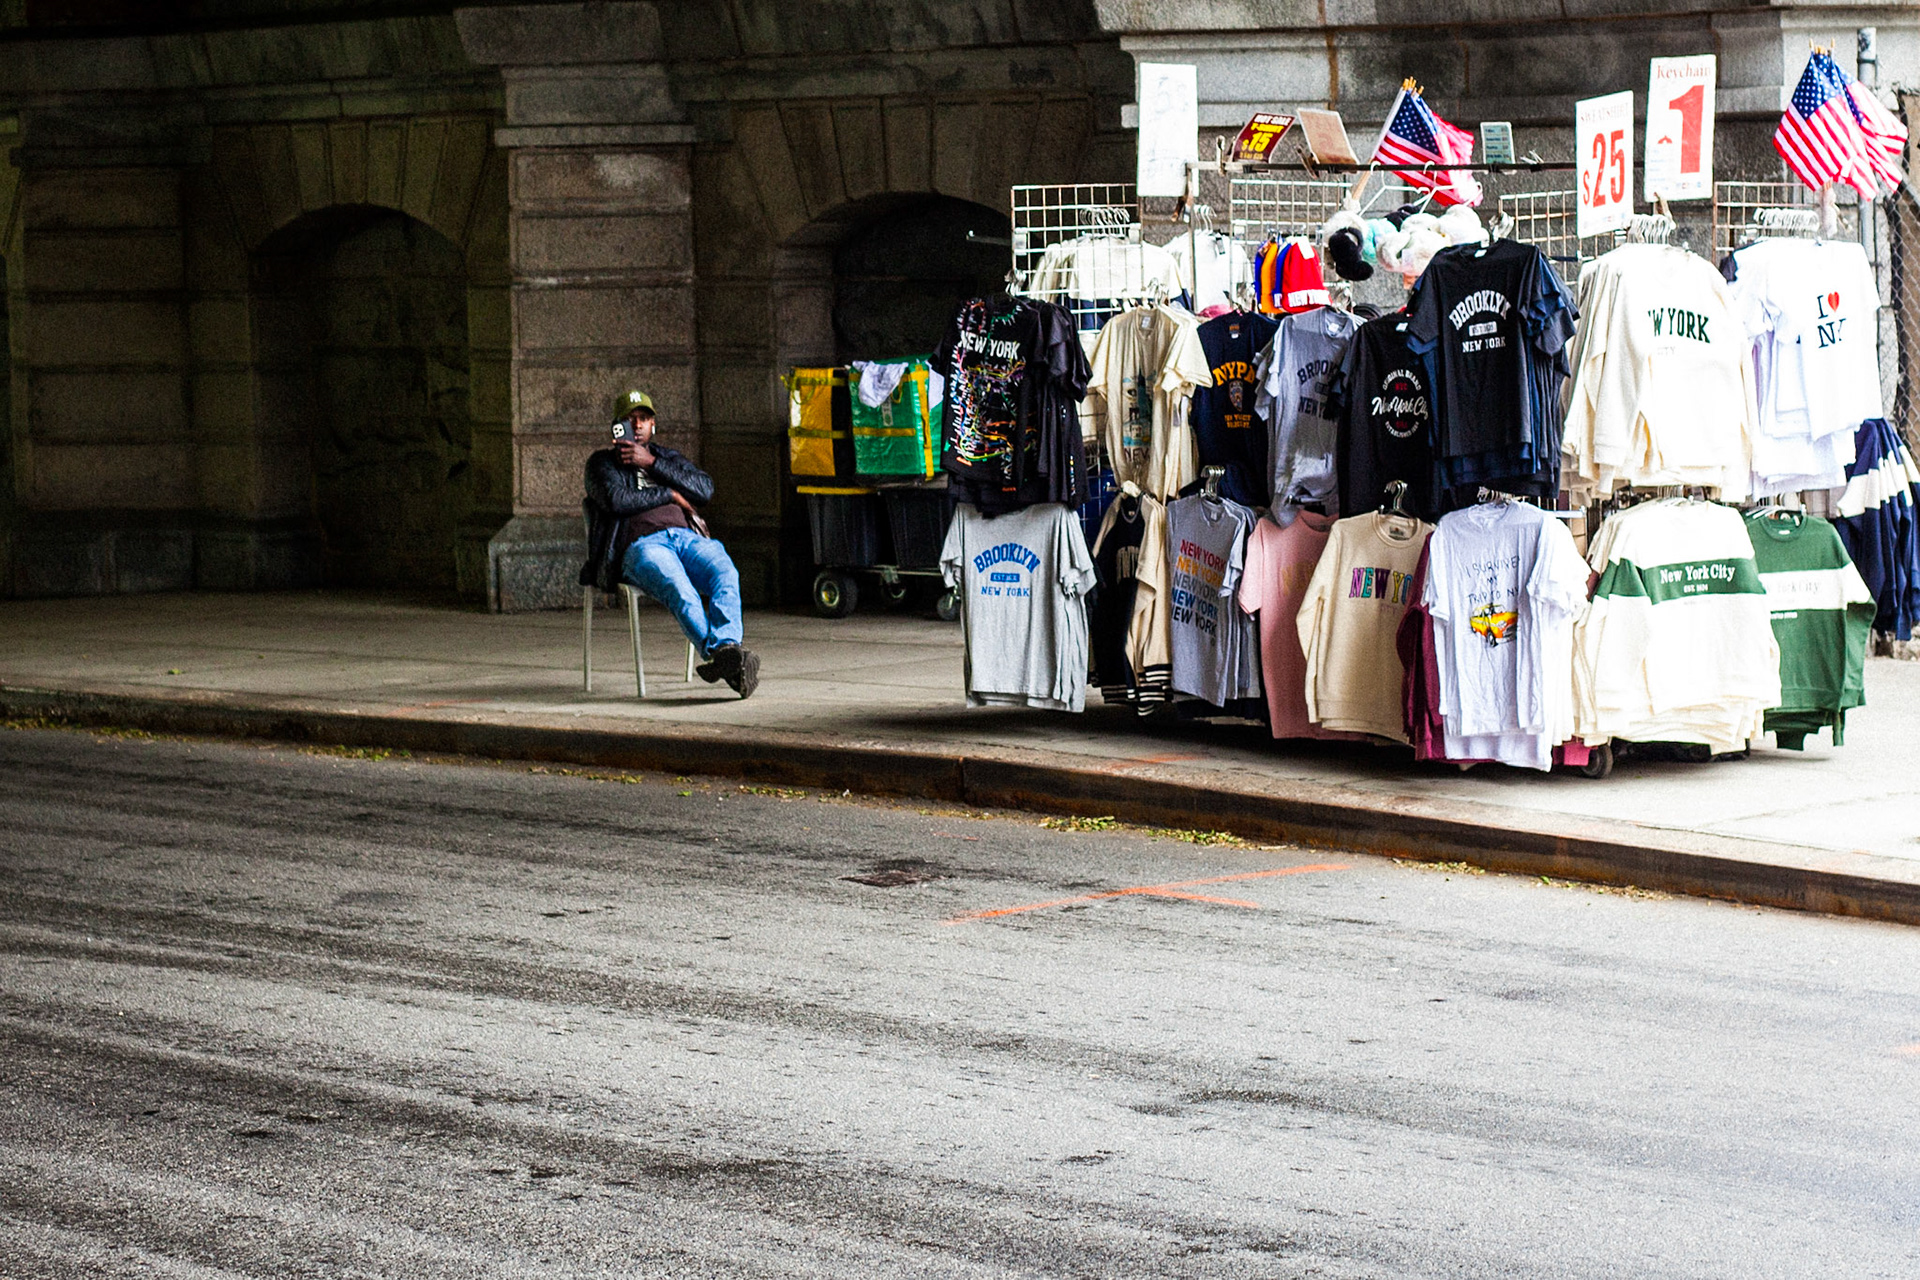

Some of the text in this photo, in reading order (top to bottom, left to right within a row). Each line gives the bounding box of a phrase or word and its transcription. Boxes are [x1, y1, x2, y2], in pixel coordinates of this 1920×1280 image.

[1657, 63, 1711, 80] Keychain
[1658, 85, 1704, 174] 1
[1583, 129, 1625, 208] $25
[1817, 294, 1829, 319] I
[1668, 307, 1711, 344] YORK
[958, 330, 1021, 360] NEW YORK
[1462, 336, 1506, 353] NEW YORK
[973, 542, 1041, 574] BROOKLYN
[1176, 555, 1199, 576] NEW
[1180, 539, 1227, 573] NEW YORK
[1472, 555, 1519, 576] SURVIVE
[1173, 570, 1196, 592] NEW
[1348, 566, 1391, 599] NEW
[1660, 563, 1735, 584] New York City
[981, 586, 1030, 597] NEW YORK
[1172, 587, 1219, 619] NEW YORK
[1172, 603, 1218, 637] EW YORK
